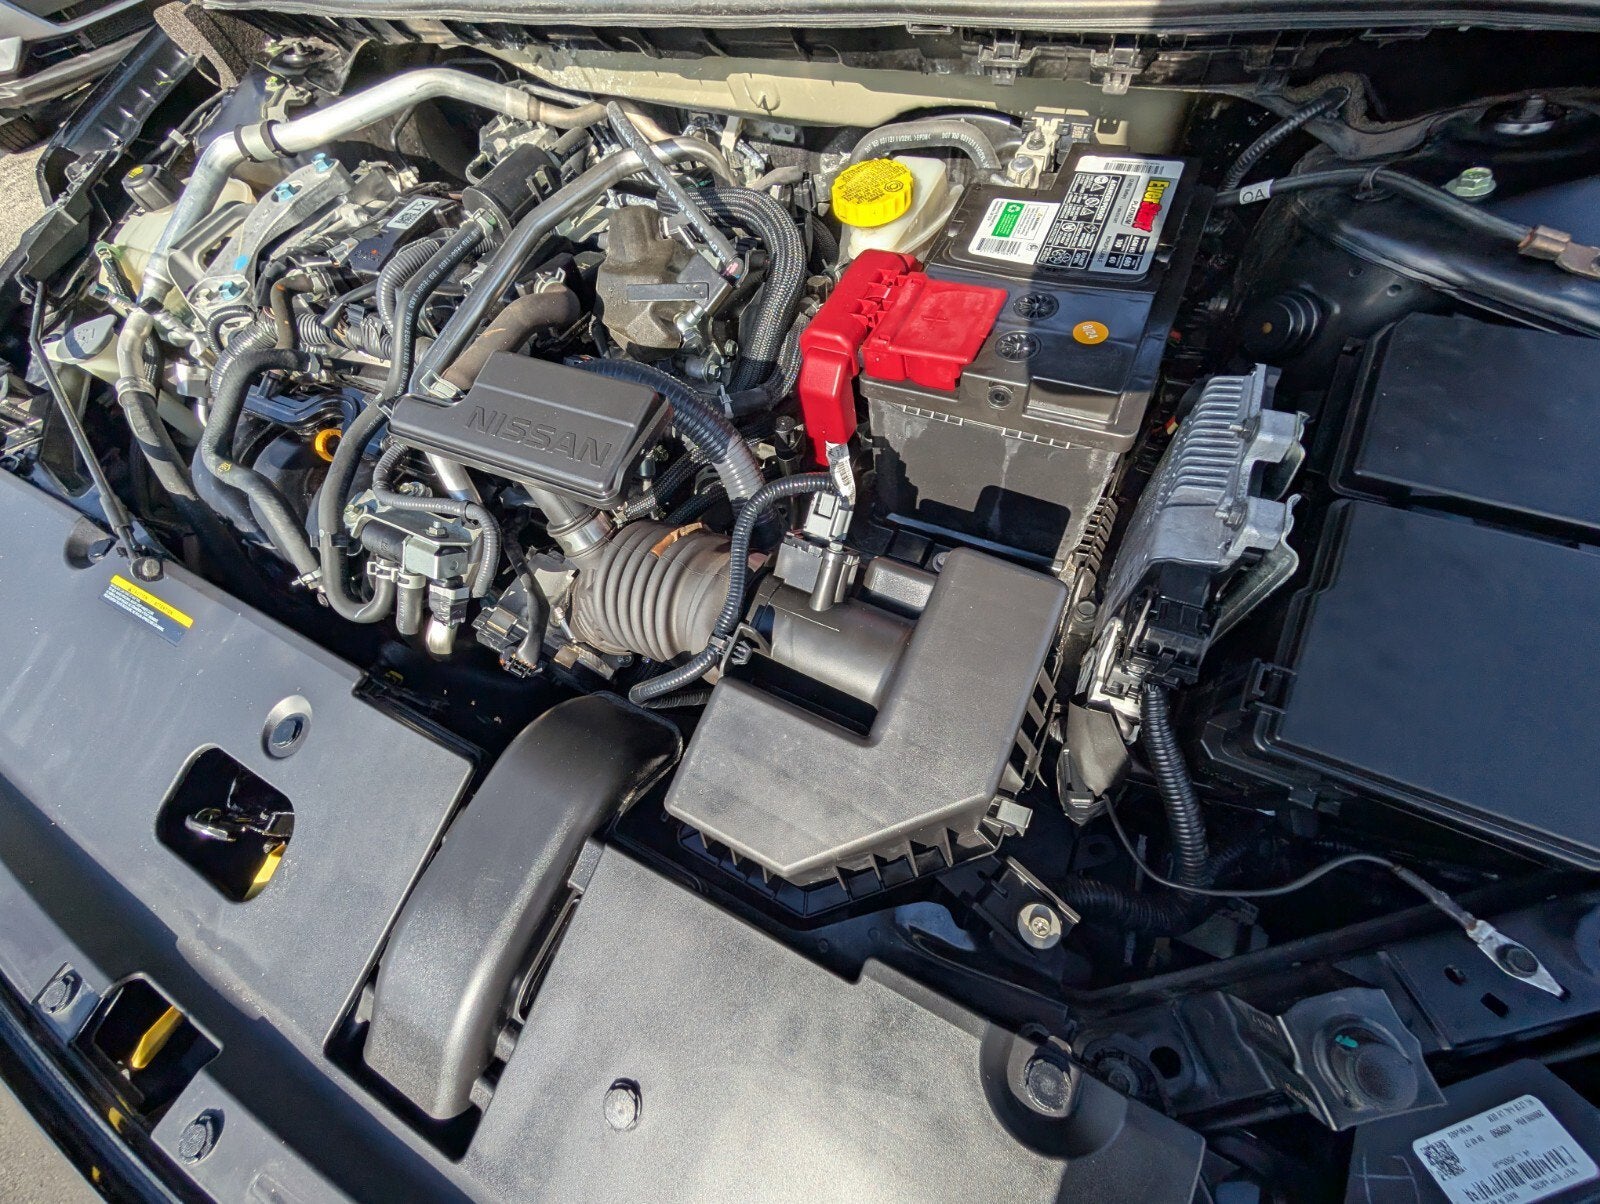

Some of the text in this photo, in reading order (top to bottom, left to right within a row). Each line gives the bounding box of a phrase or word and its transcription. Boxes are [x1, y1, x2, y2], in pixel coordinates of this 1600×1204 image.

[1124, 200, 1139, 225] PLATINUM
[1131, 179, 1171, 233] EverStart
[464, 405, 613, 469] NISSAN
